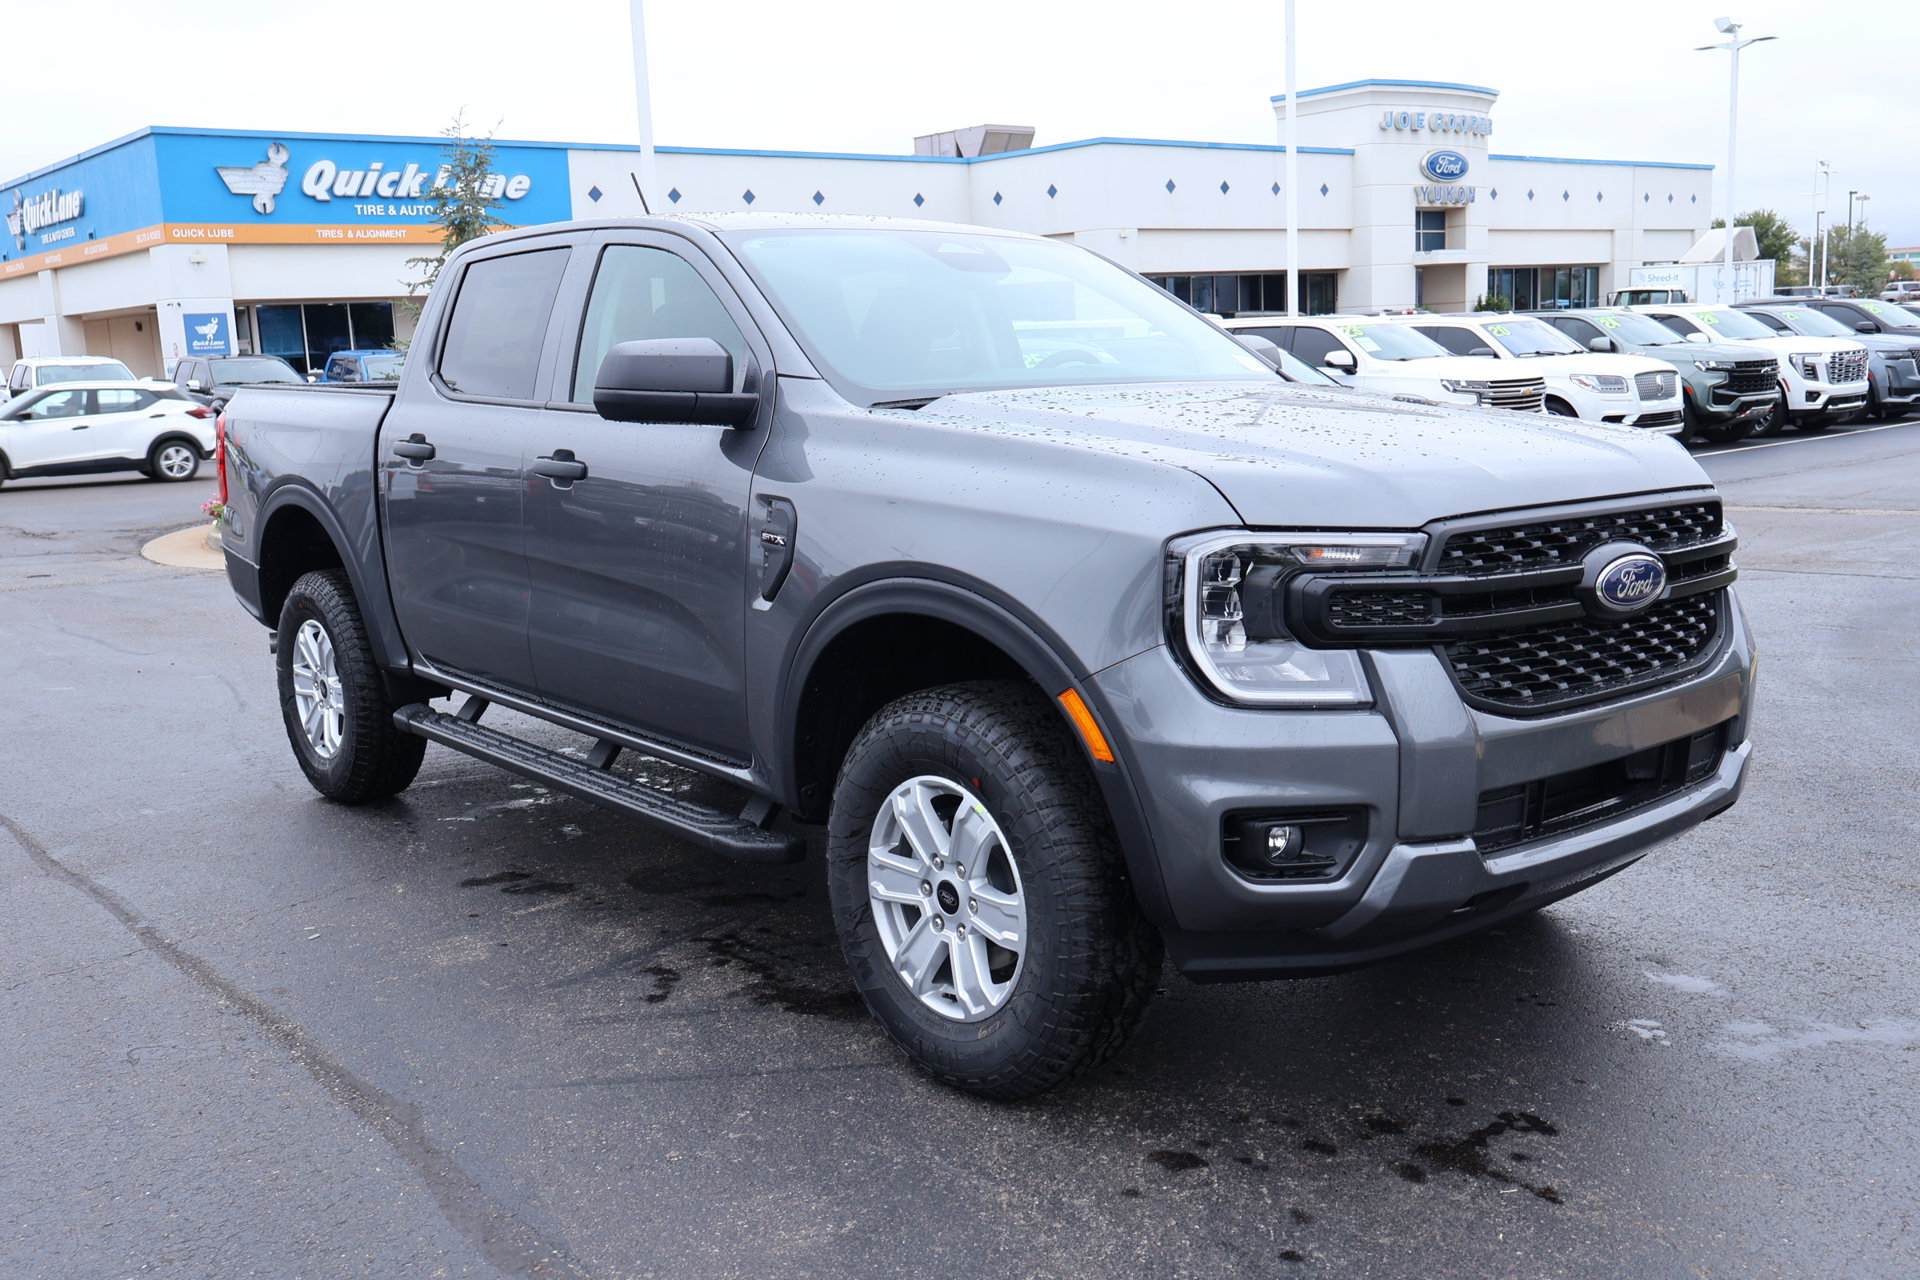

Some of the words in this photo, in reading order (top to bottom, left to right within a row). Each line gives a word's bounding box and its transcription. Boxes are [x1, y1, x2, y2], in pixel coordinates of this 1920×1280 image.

[1380, 111, 1425, 131] JOE
[1435, 155, 1461, 174] Ford
[302, 159, 430, 201] Quick
[1414, 186, 1475, 204] YUKON
[23, 192, 51, 235] Quick
[51, 189, 84, 222] Lane
[354, 204, 385, 216] TIRE
[387, 204, 397, 216] &
[399, 204, 434, 217] AUTO
[172, 228, 206, 238] QUICK
[207, 229, 235, 238] LUBE
[316, 229, 344, 238] TIRES
[347, 229, 354, 238] &
[355, 229, 407, 238] ALIGNMENT
[1647, 273, 1680, 283] Shred-it
[1617, 566, 1654, 599] Ford
